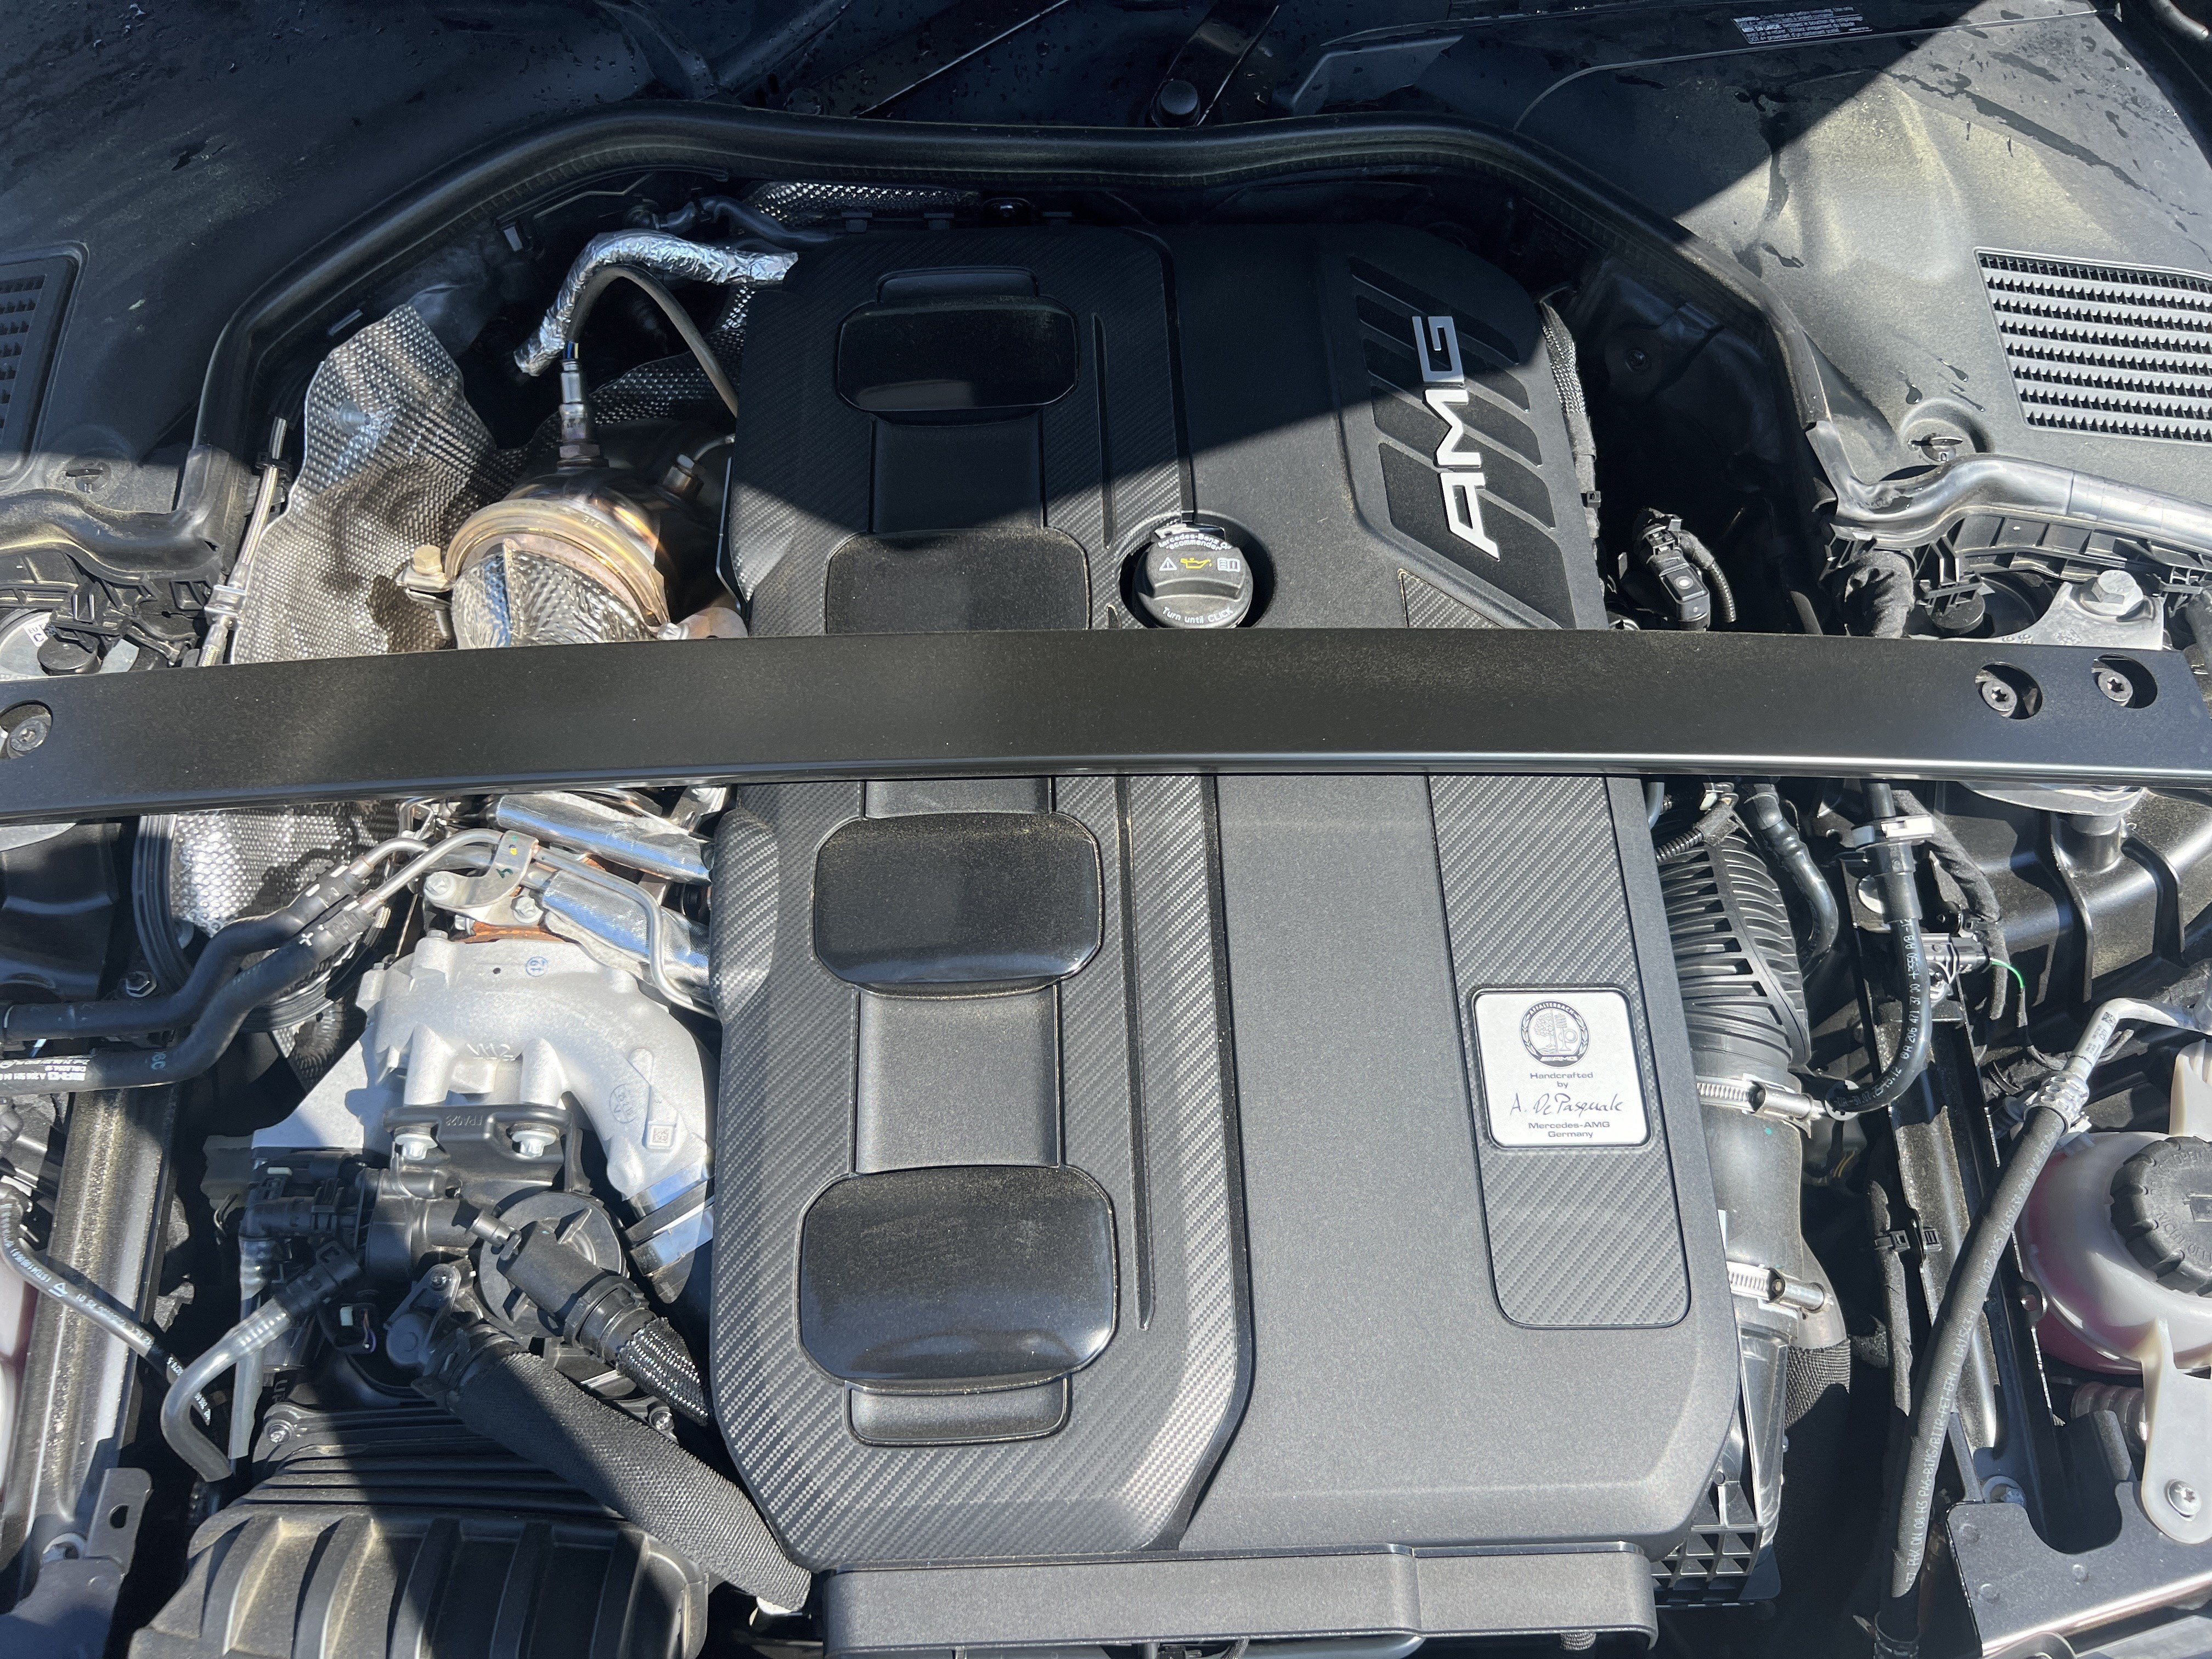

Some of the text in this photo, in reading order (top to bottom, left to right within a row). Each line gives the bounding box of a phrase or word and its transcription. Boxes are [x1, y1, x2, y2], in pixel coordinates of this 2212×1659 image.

[1412, 316, 1500, 562] AMG
[1162, 606, 1233, 624] Turn until CLICK
[1556, 1081, 1568, 1089] by
